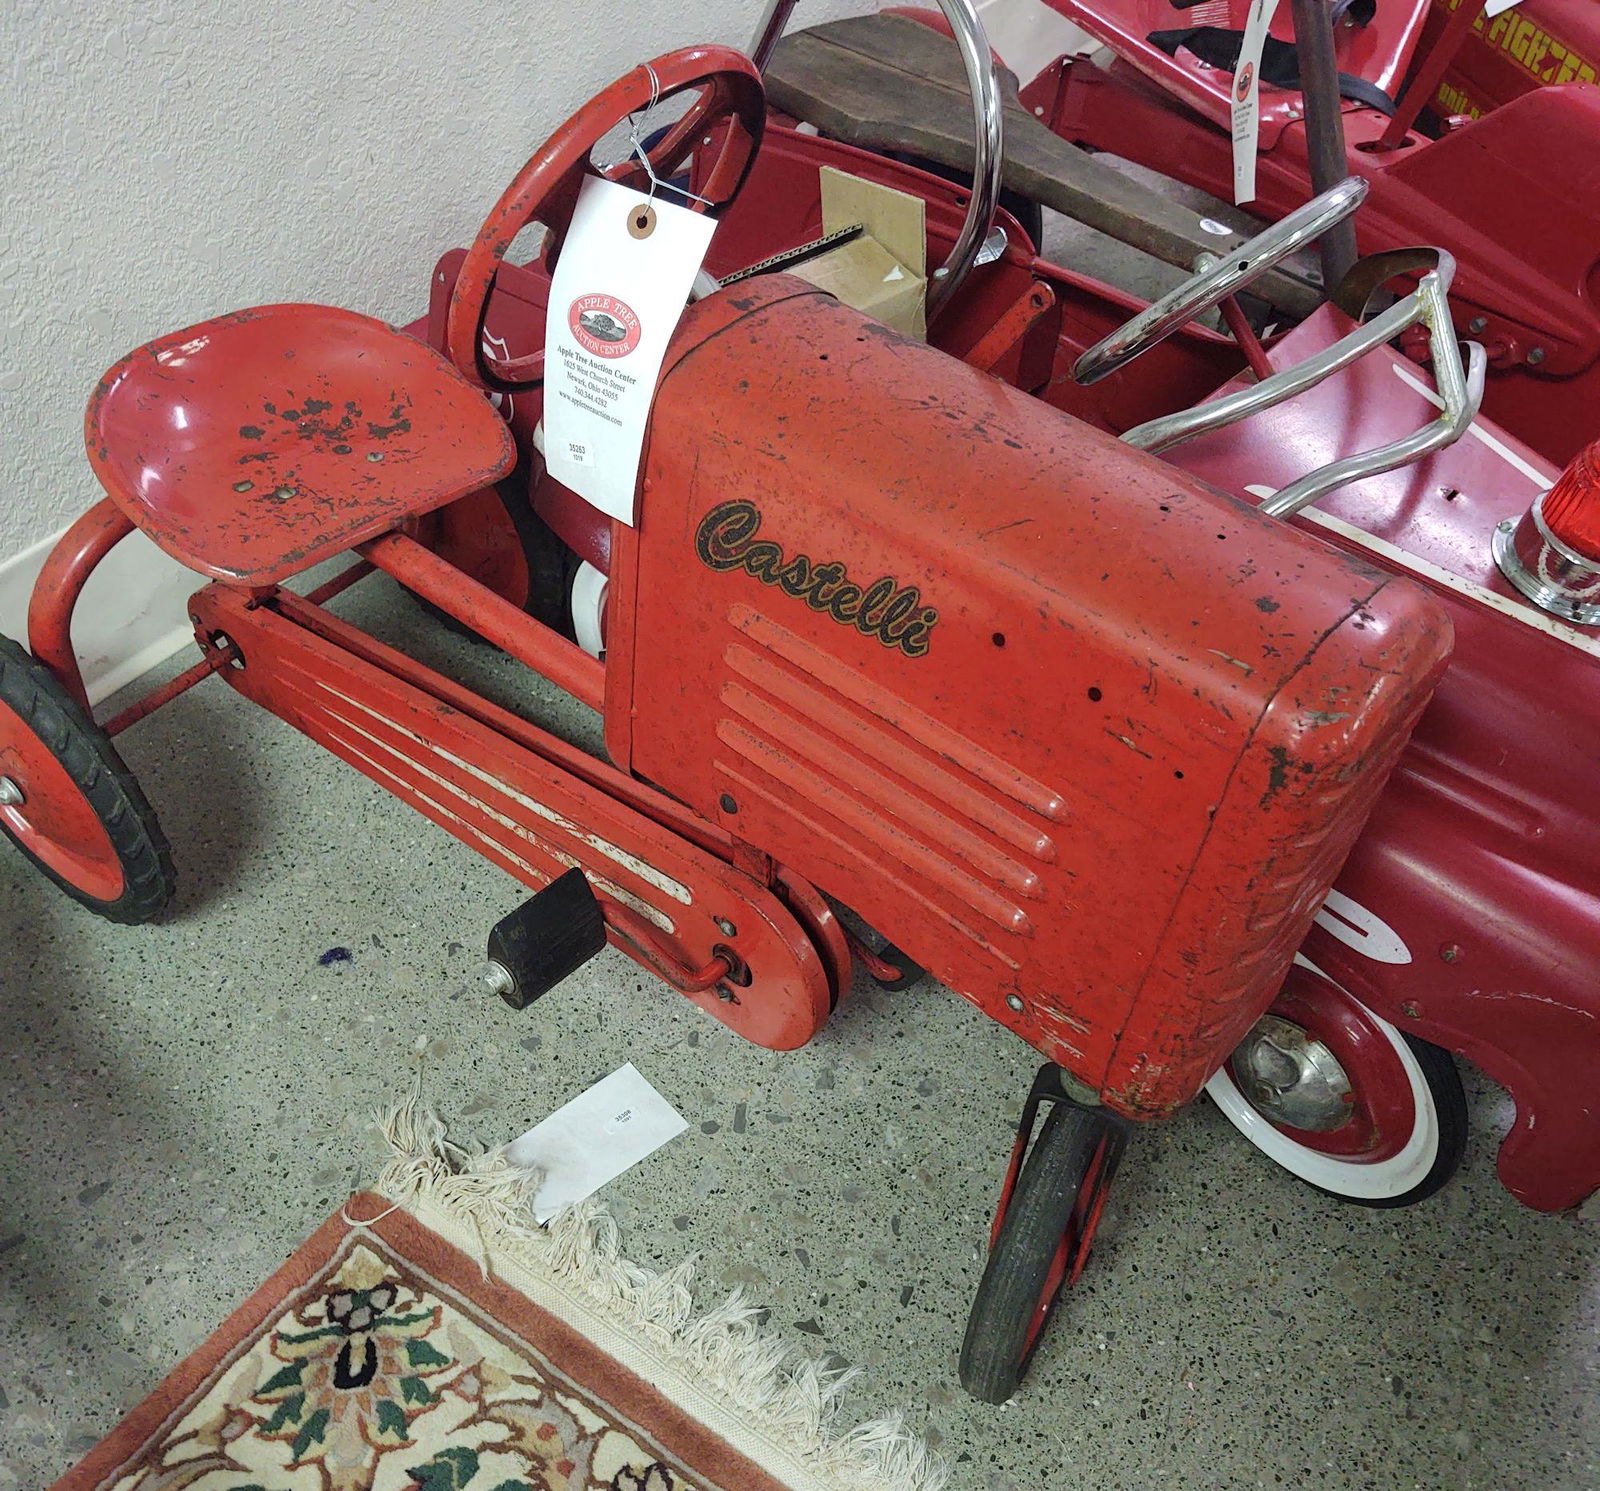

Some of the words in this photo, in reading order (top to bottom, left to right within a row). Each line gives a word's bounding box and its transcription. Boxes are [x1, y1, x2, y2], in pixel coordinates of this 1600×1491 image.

[577, 297, 611, 312] APPLE
[614, 302, 638, 329] TREE
[573, 324, 600, 351] AUCTION
[600, 342, 630, 355] CENTER
[557, 345, 574, 358] Apple
[575, 352, 588, 364] Tree
[588, 359, 613, 375] Auction
[614, 369, 637, 385] Center
[588, 382, 601, 394] Ohio
[589, 371, 609, 385] Church
[609, 380, 626, 393] Street
[695, 498, 939, 658] Castelli
